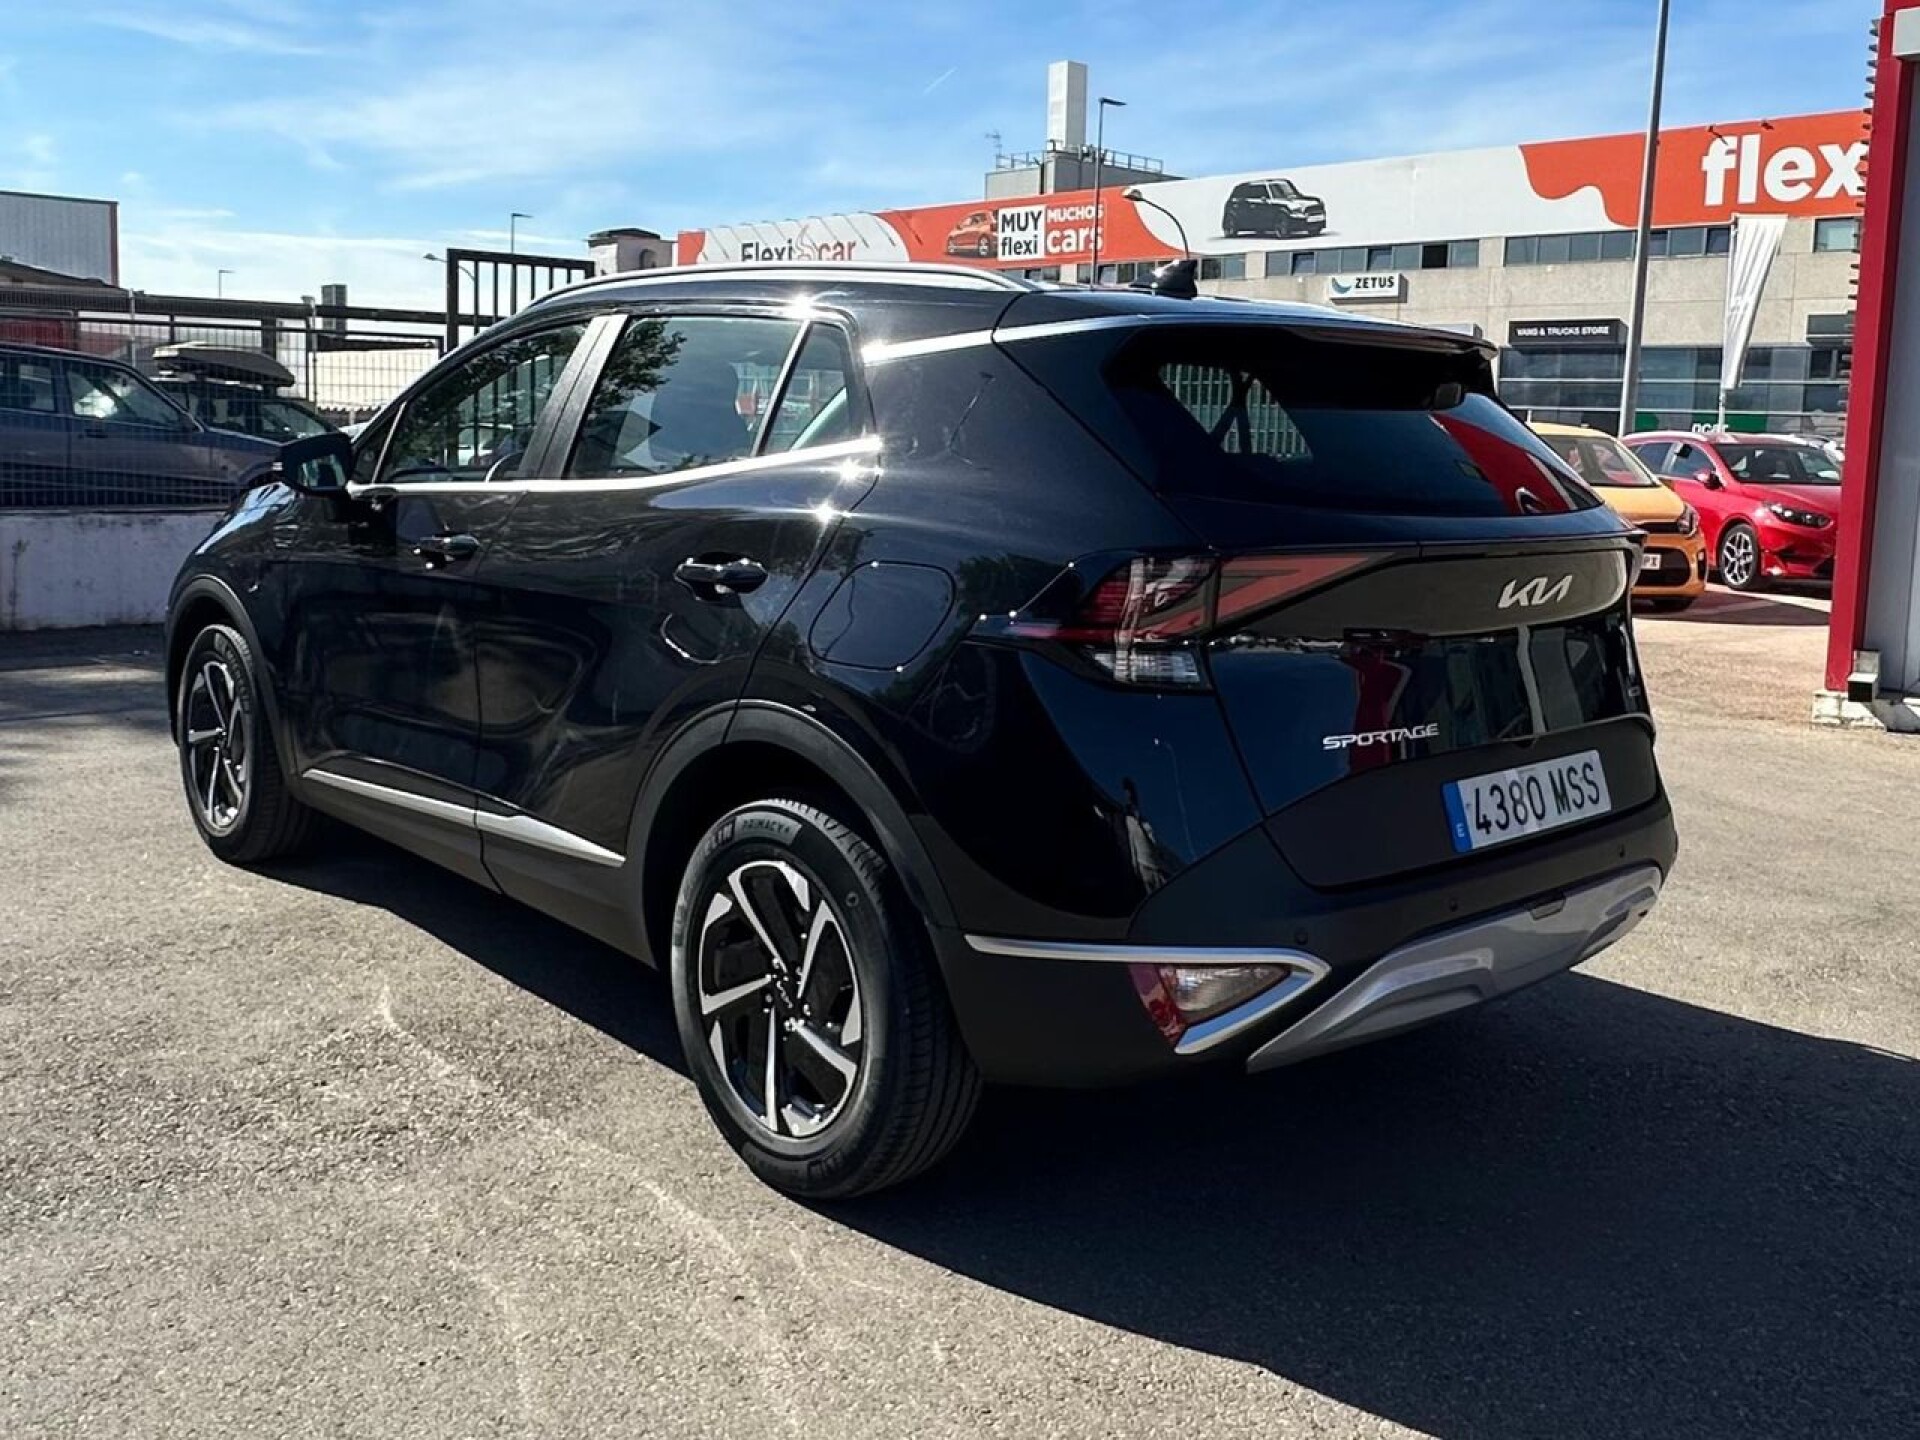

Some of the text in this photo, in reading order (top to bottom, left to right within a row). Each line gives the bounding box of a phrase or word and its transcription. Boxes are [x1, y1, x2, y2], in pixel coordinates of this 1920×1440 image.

[1701, 134, 1869, 207] flex
[1001, 209, 1042, 233] MUY
[1046, 204, 1105, 223] MUCHOS
[1001, 234, 1038, 256] flexi
[1046, 226, 1104, 254] cars
[1355, 275, 1395, 289] ZETUS
[1547, 326, 1580, 336] TRUCKS
[1581, 326, 1609, 335] STORE
[1322, 722, 1440, 750] SPORTAGE
[1475, 762, 1600, 834] 4380 MSS
[1456, 822, 1465, 838] E
